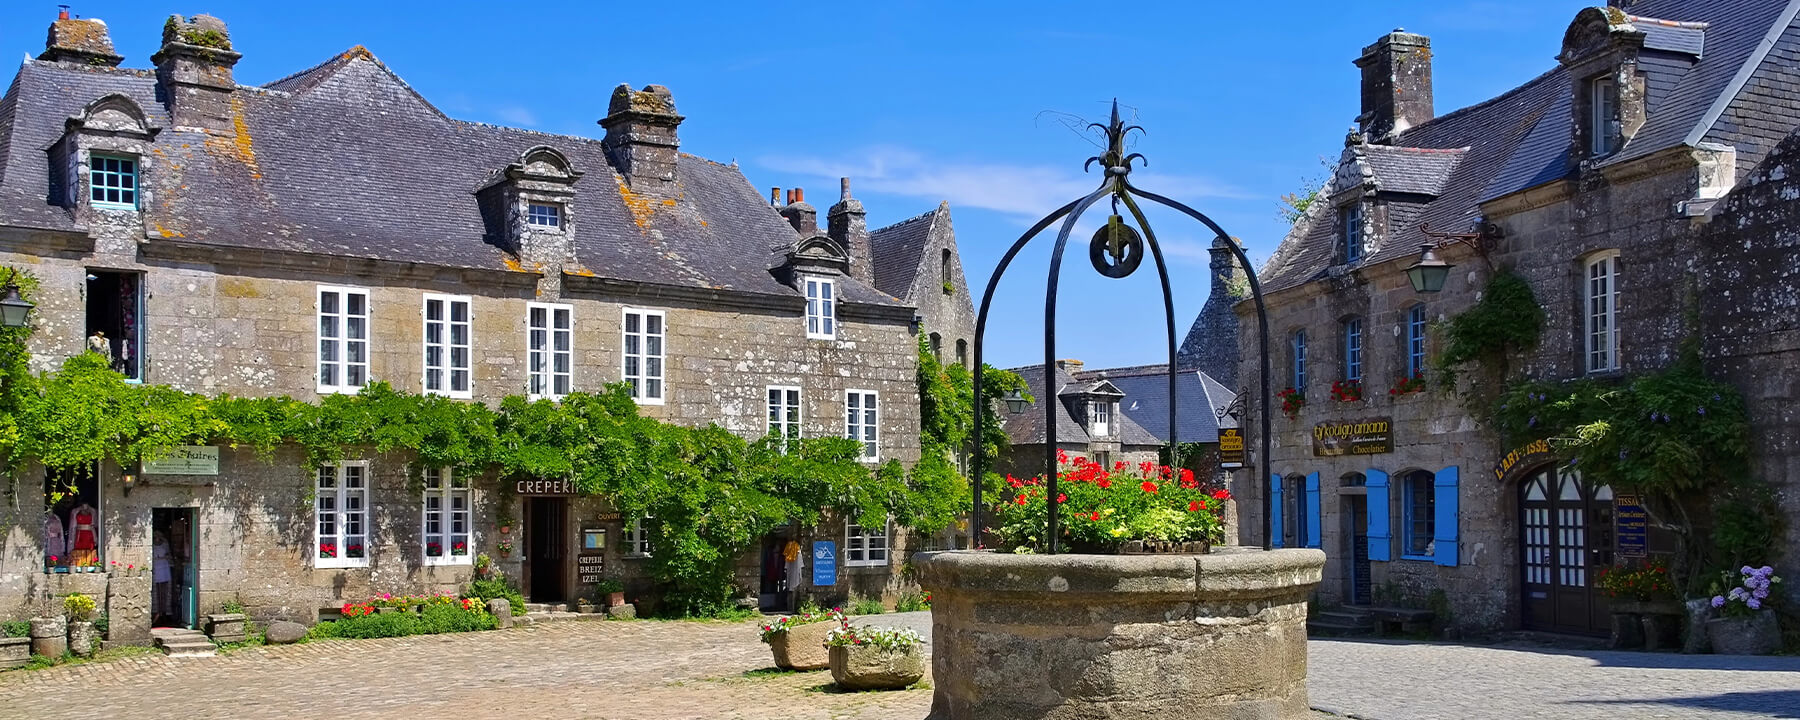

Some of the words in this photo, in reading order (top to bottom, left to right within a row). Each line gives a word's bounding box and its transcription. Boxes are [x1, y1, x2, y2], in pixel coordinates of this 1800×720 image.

[1324, 423, 1353, 439] kouign
[1353, 421, 1388, 434] amann
[1352, 444, 1386, 455] Chocolatier
[1618, 497, 1639, 506] TISSA
[579, 565, 603, 573] BREIZ
[582, 575, 600, 583] IZEL
